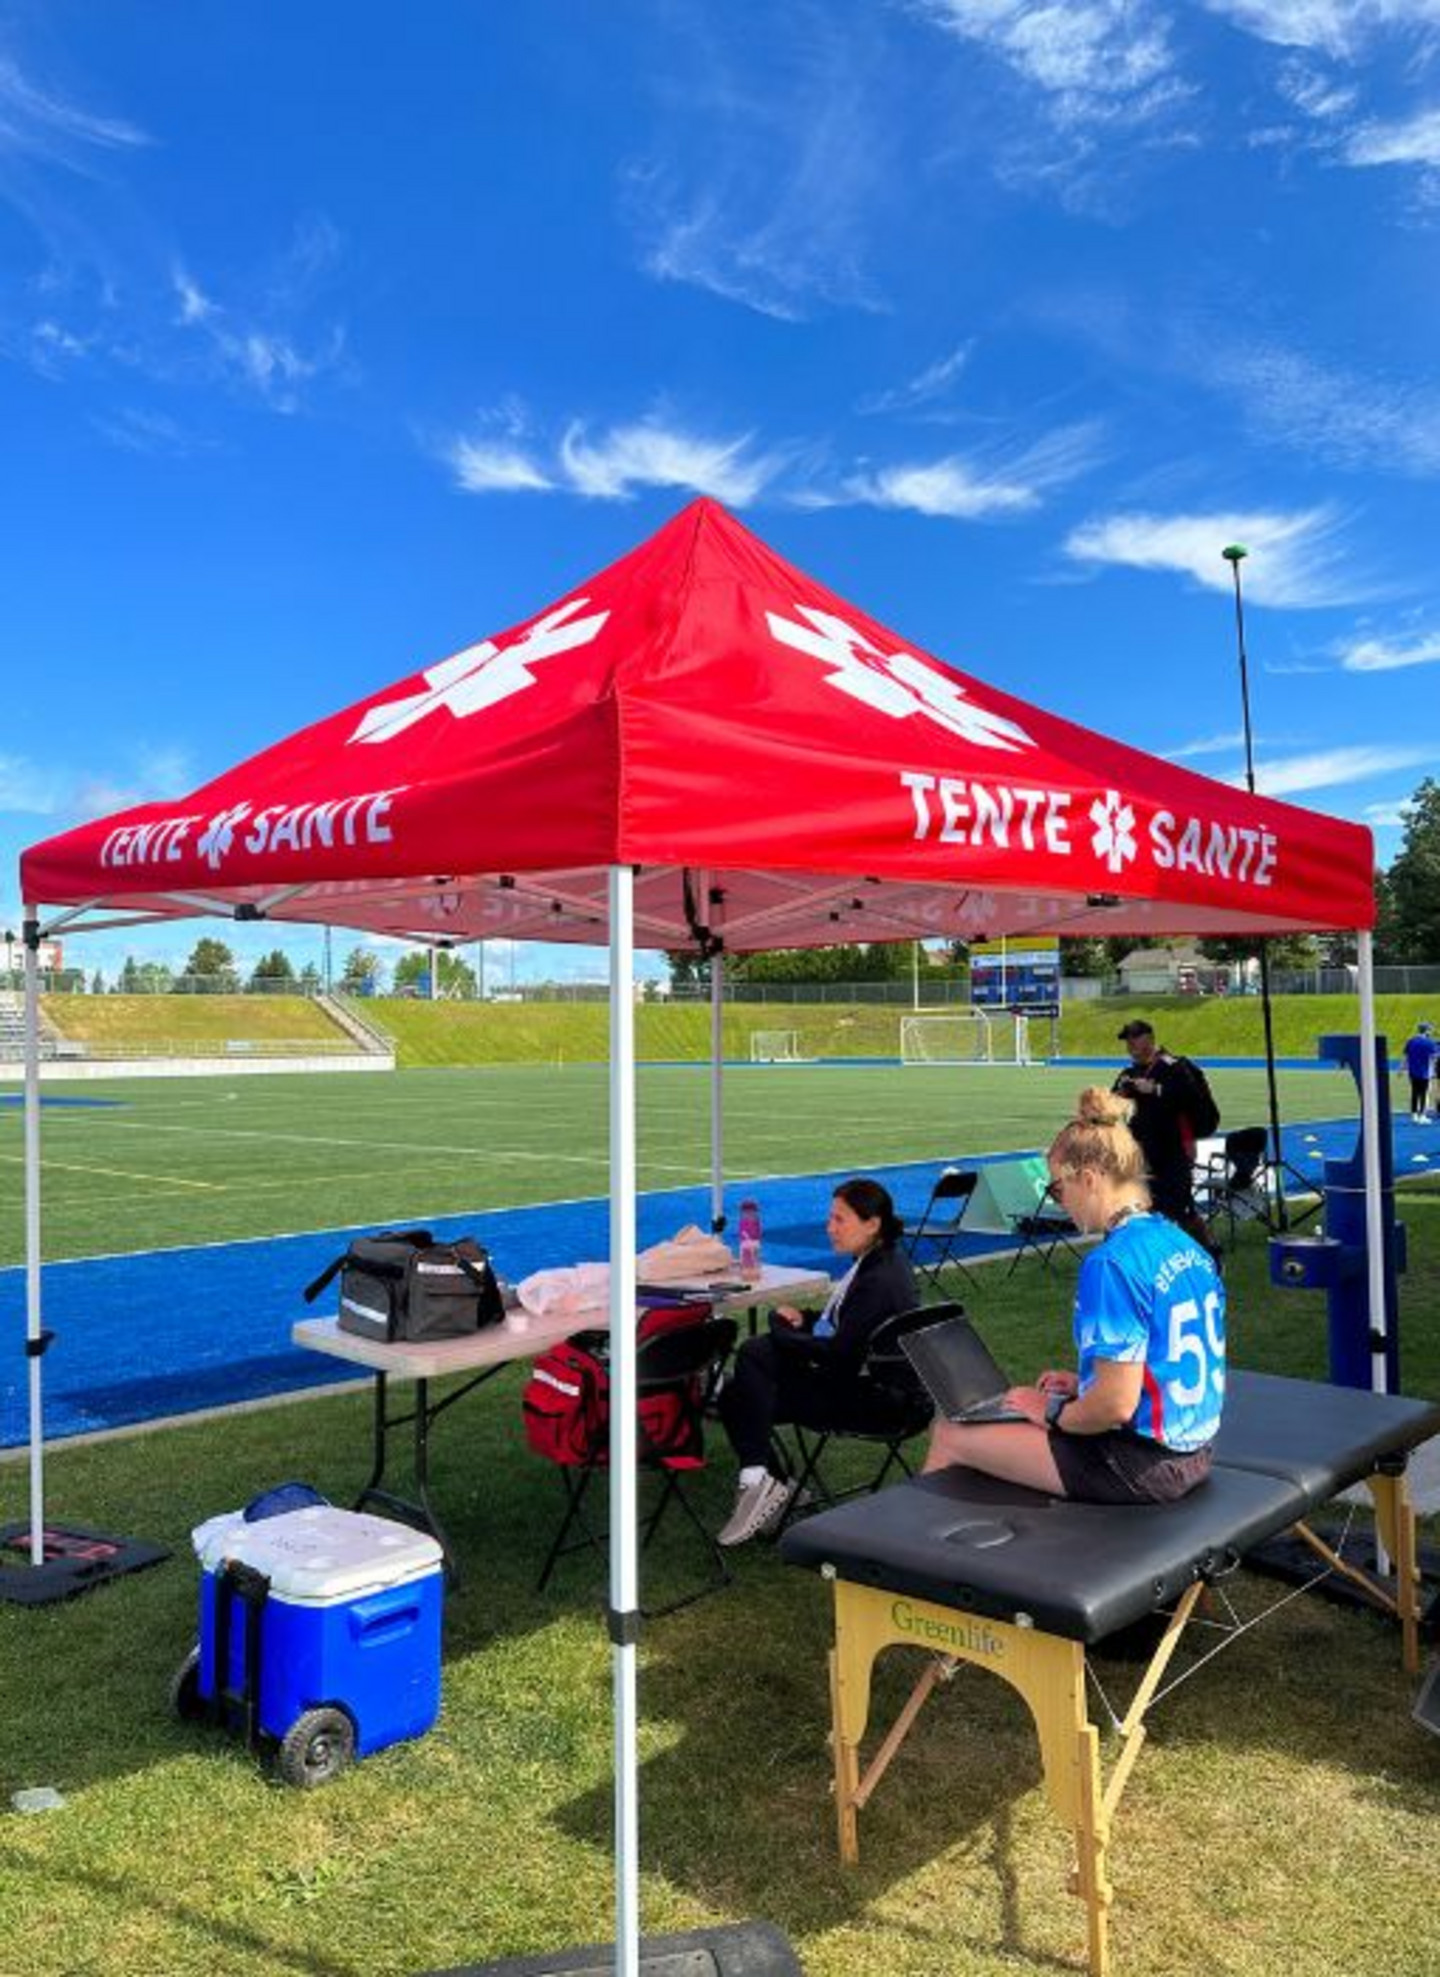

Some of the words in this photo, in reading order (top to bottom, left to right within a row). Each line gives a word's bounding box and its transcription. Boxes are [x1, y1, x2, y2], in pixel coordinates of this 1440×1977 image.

[100, 814, 204, 868] TENTE
[901, 771, 1072, 855] TENTE
[891, 1600, 1008, 1659] Greenlife
